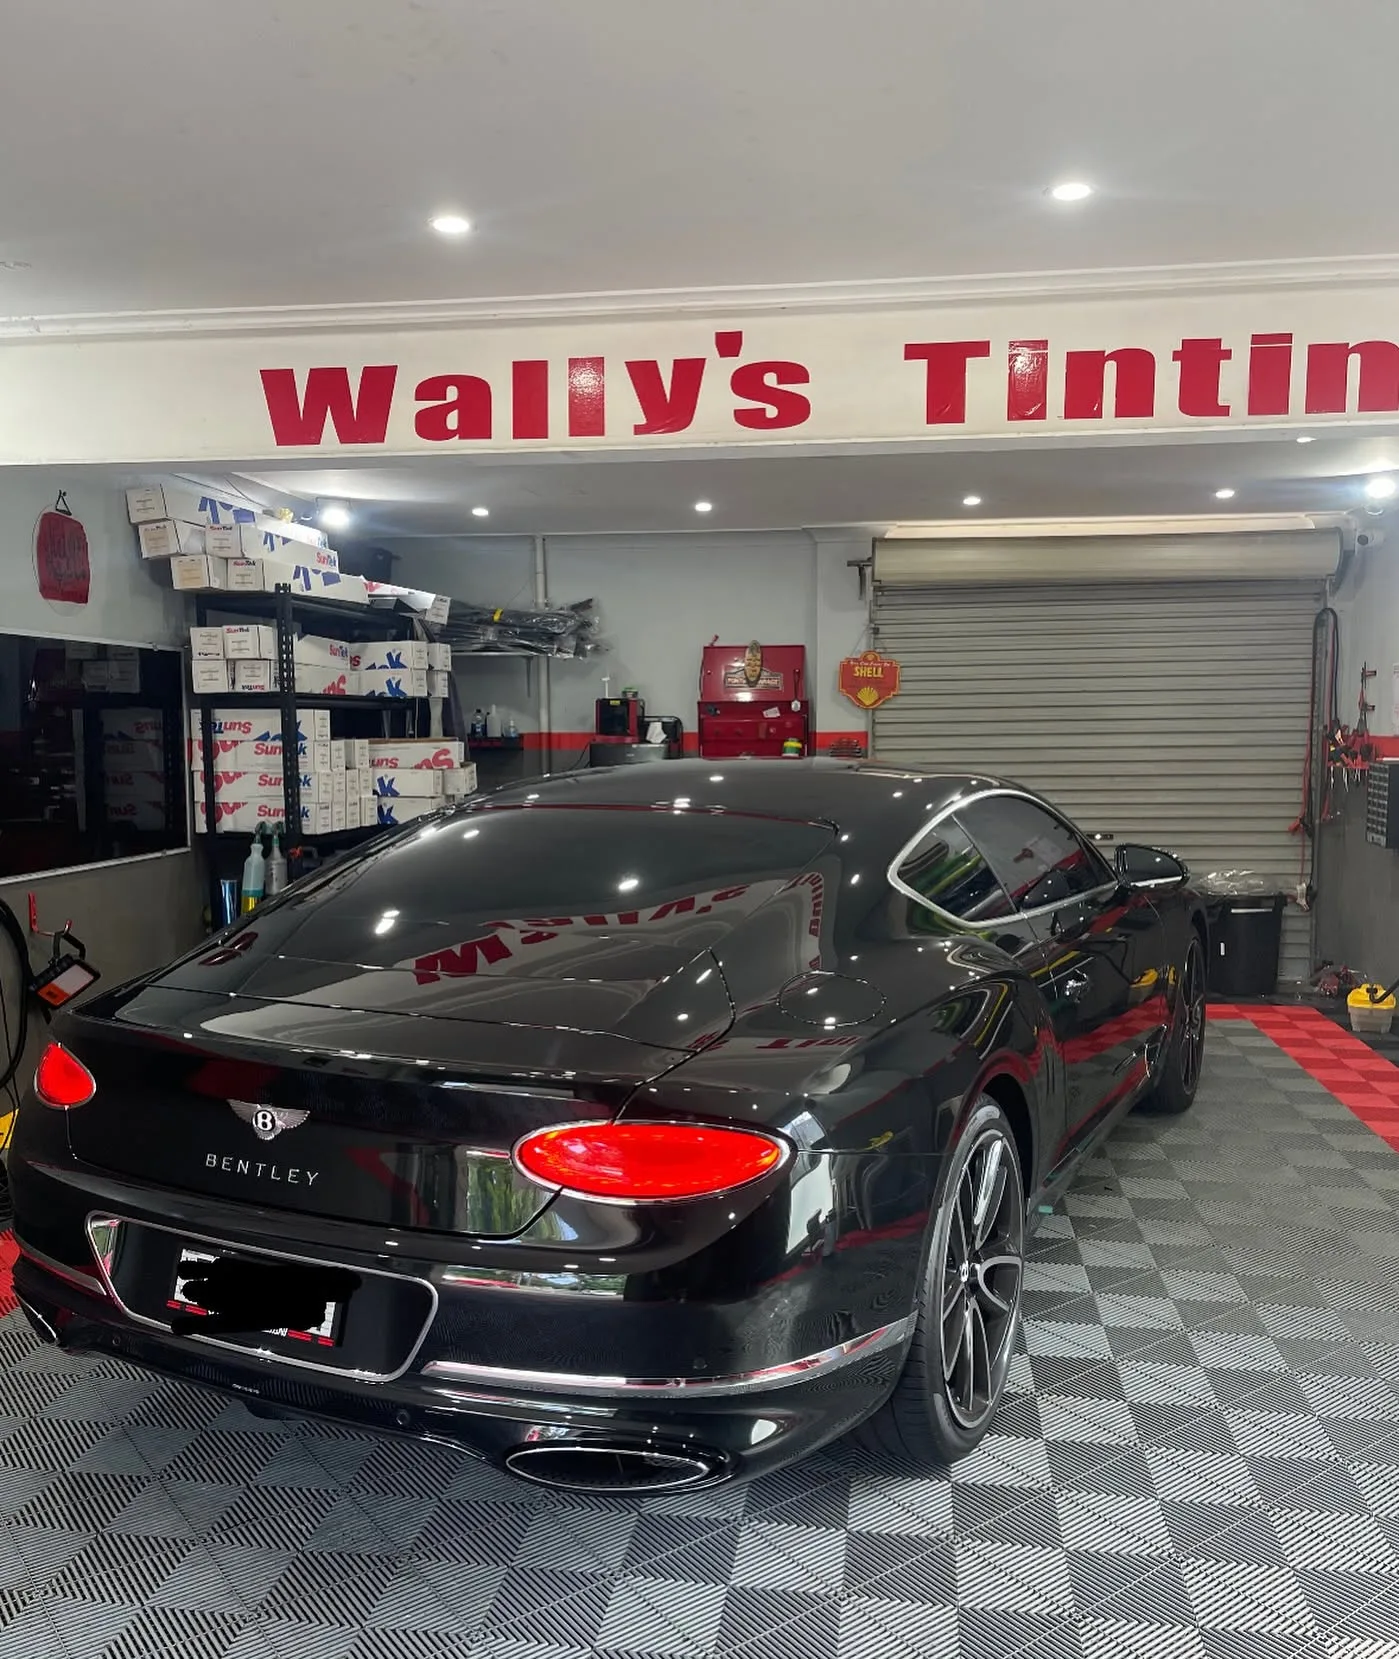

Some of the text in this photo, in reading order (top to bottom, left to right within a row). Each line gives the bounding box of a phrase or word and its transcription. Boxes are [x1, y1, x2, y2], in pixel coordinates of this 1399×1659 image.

[259, 330, 811, 447] Wally's
[853, 666, 884, 678] SHELL
[205, 1153, 319, 1186] BENTLEY
